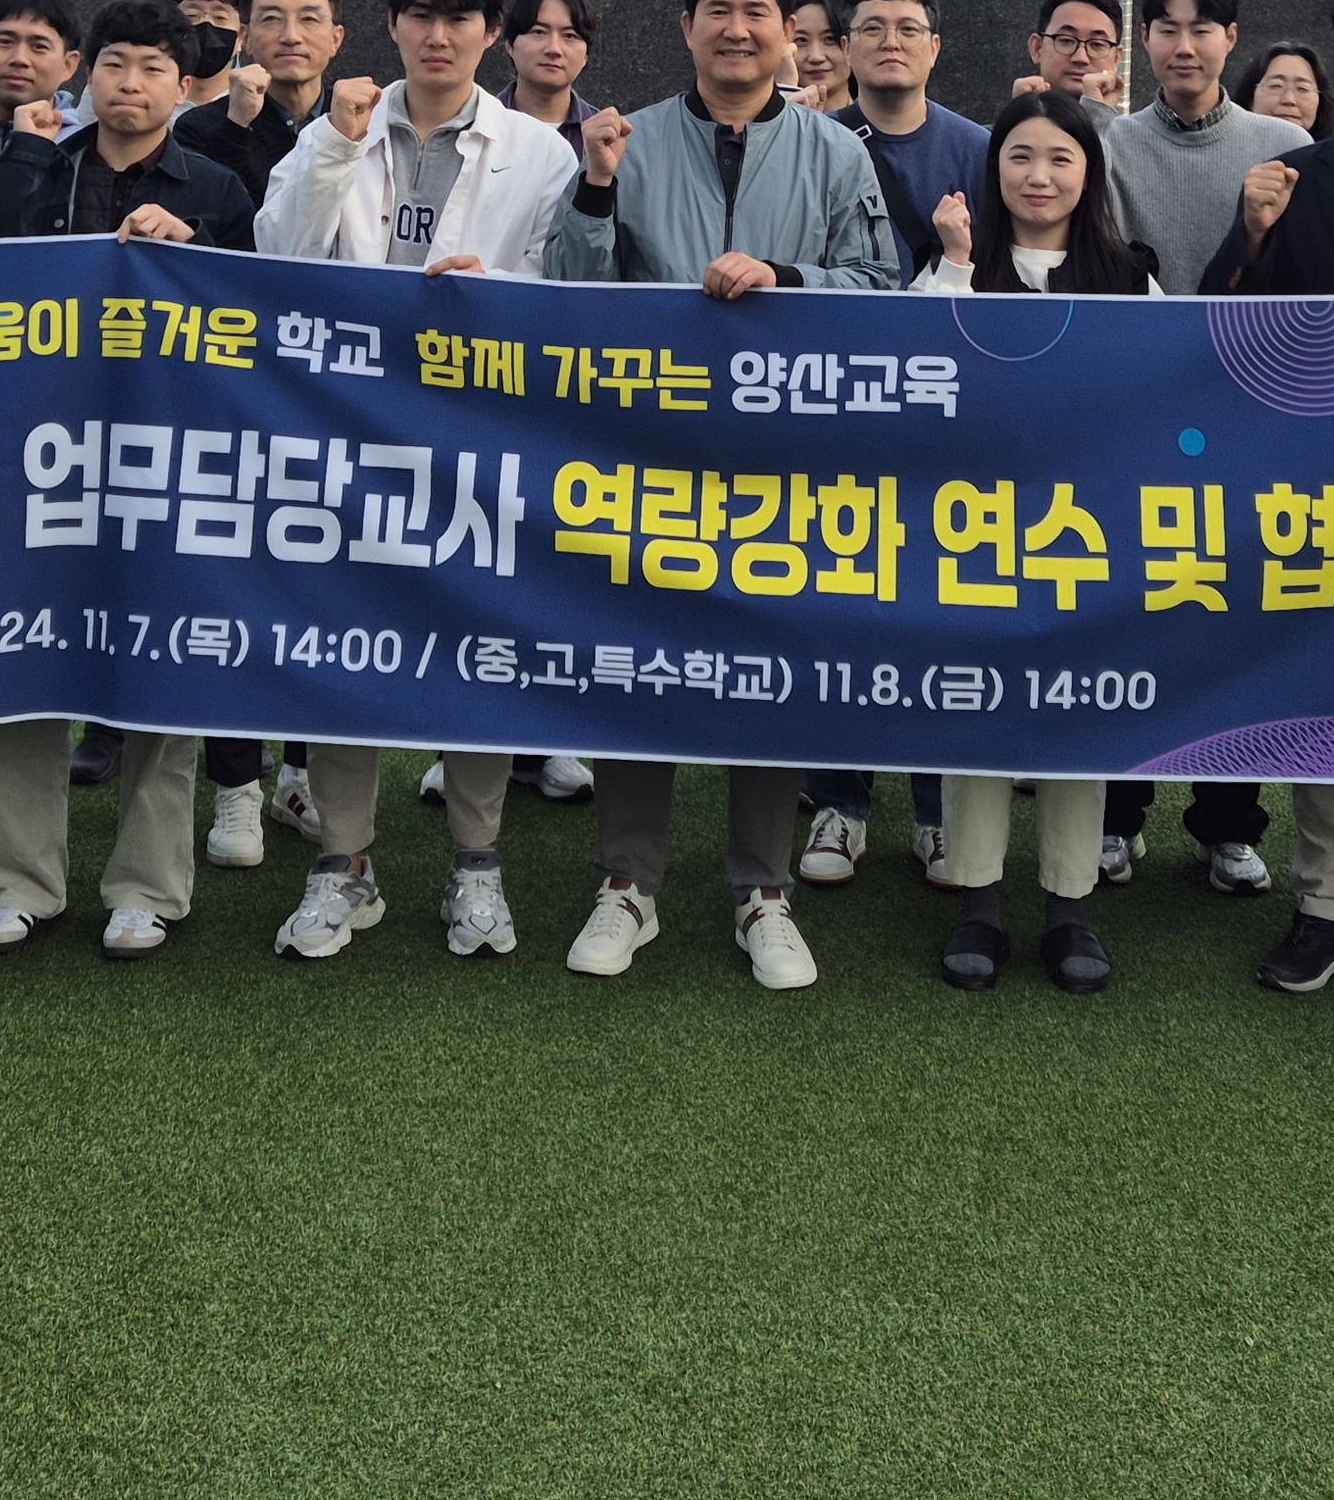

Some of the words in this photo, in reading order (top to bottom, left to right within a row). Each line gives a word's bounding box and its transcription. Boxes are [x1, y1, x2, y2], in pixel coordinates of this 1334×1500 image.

[98, 297, 258, 369] 즐거운
[275, 310, 385, 378] 학교
[415, 329, 525, 397] 함께
[542, 345, 712, 411] 가꾸는
[729, 350, 961, 419] 양산교육
[22, 419, 526, 578] 업무담당교사
[553, 460, 906, 602] 역량강화
[932, 479, 1110, 612] 연수
[1139, 483, 1230, 613] 및
[271, 623, 403, 674] 14:00
[455, 634, 794, 705] (중,고,특수학교)
[1023, 668, 1158, 713] 14:00
